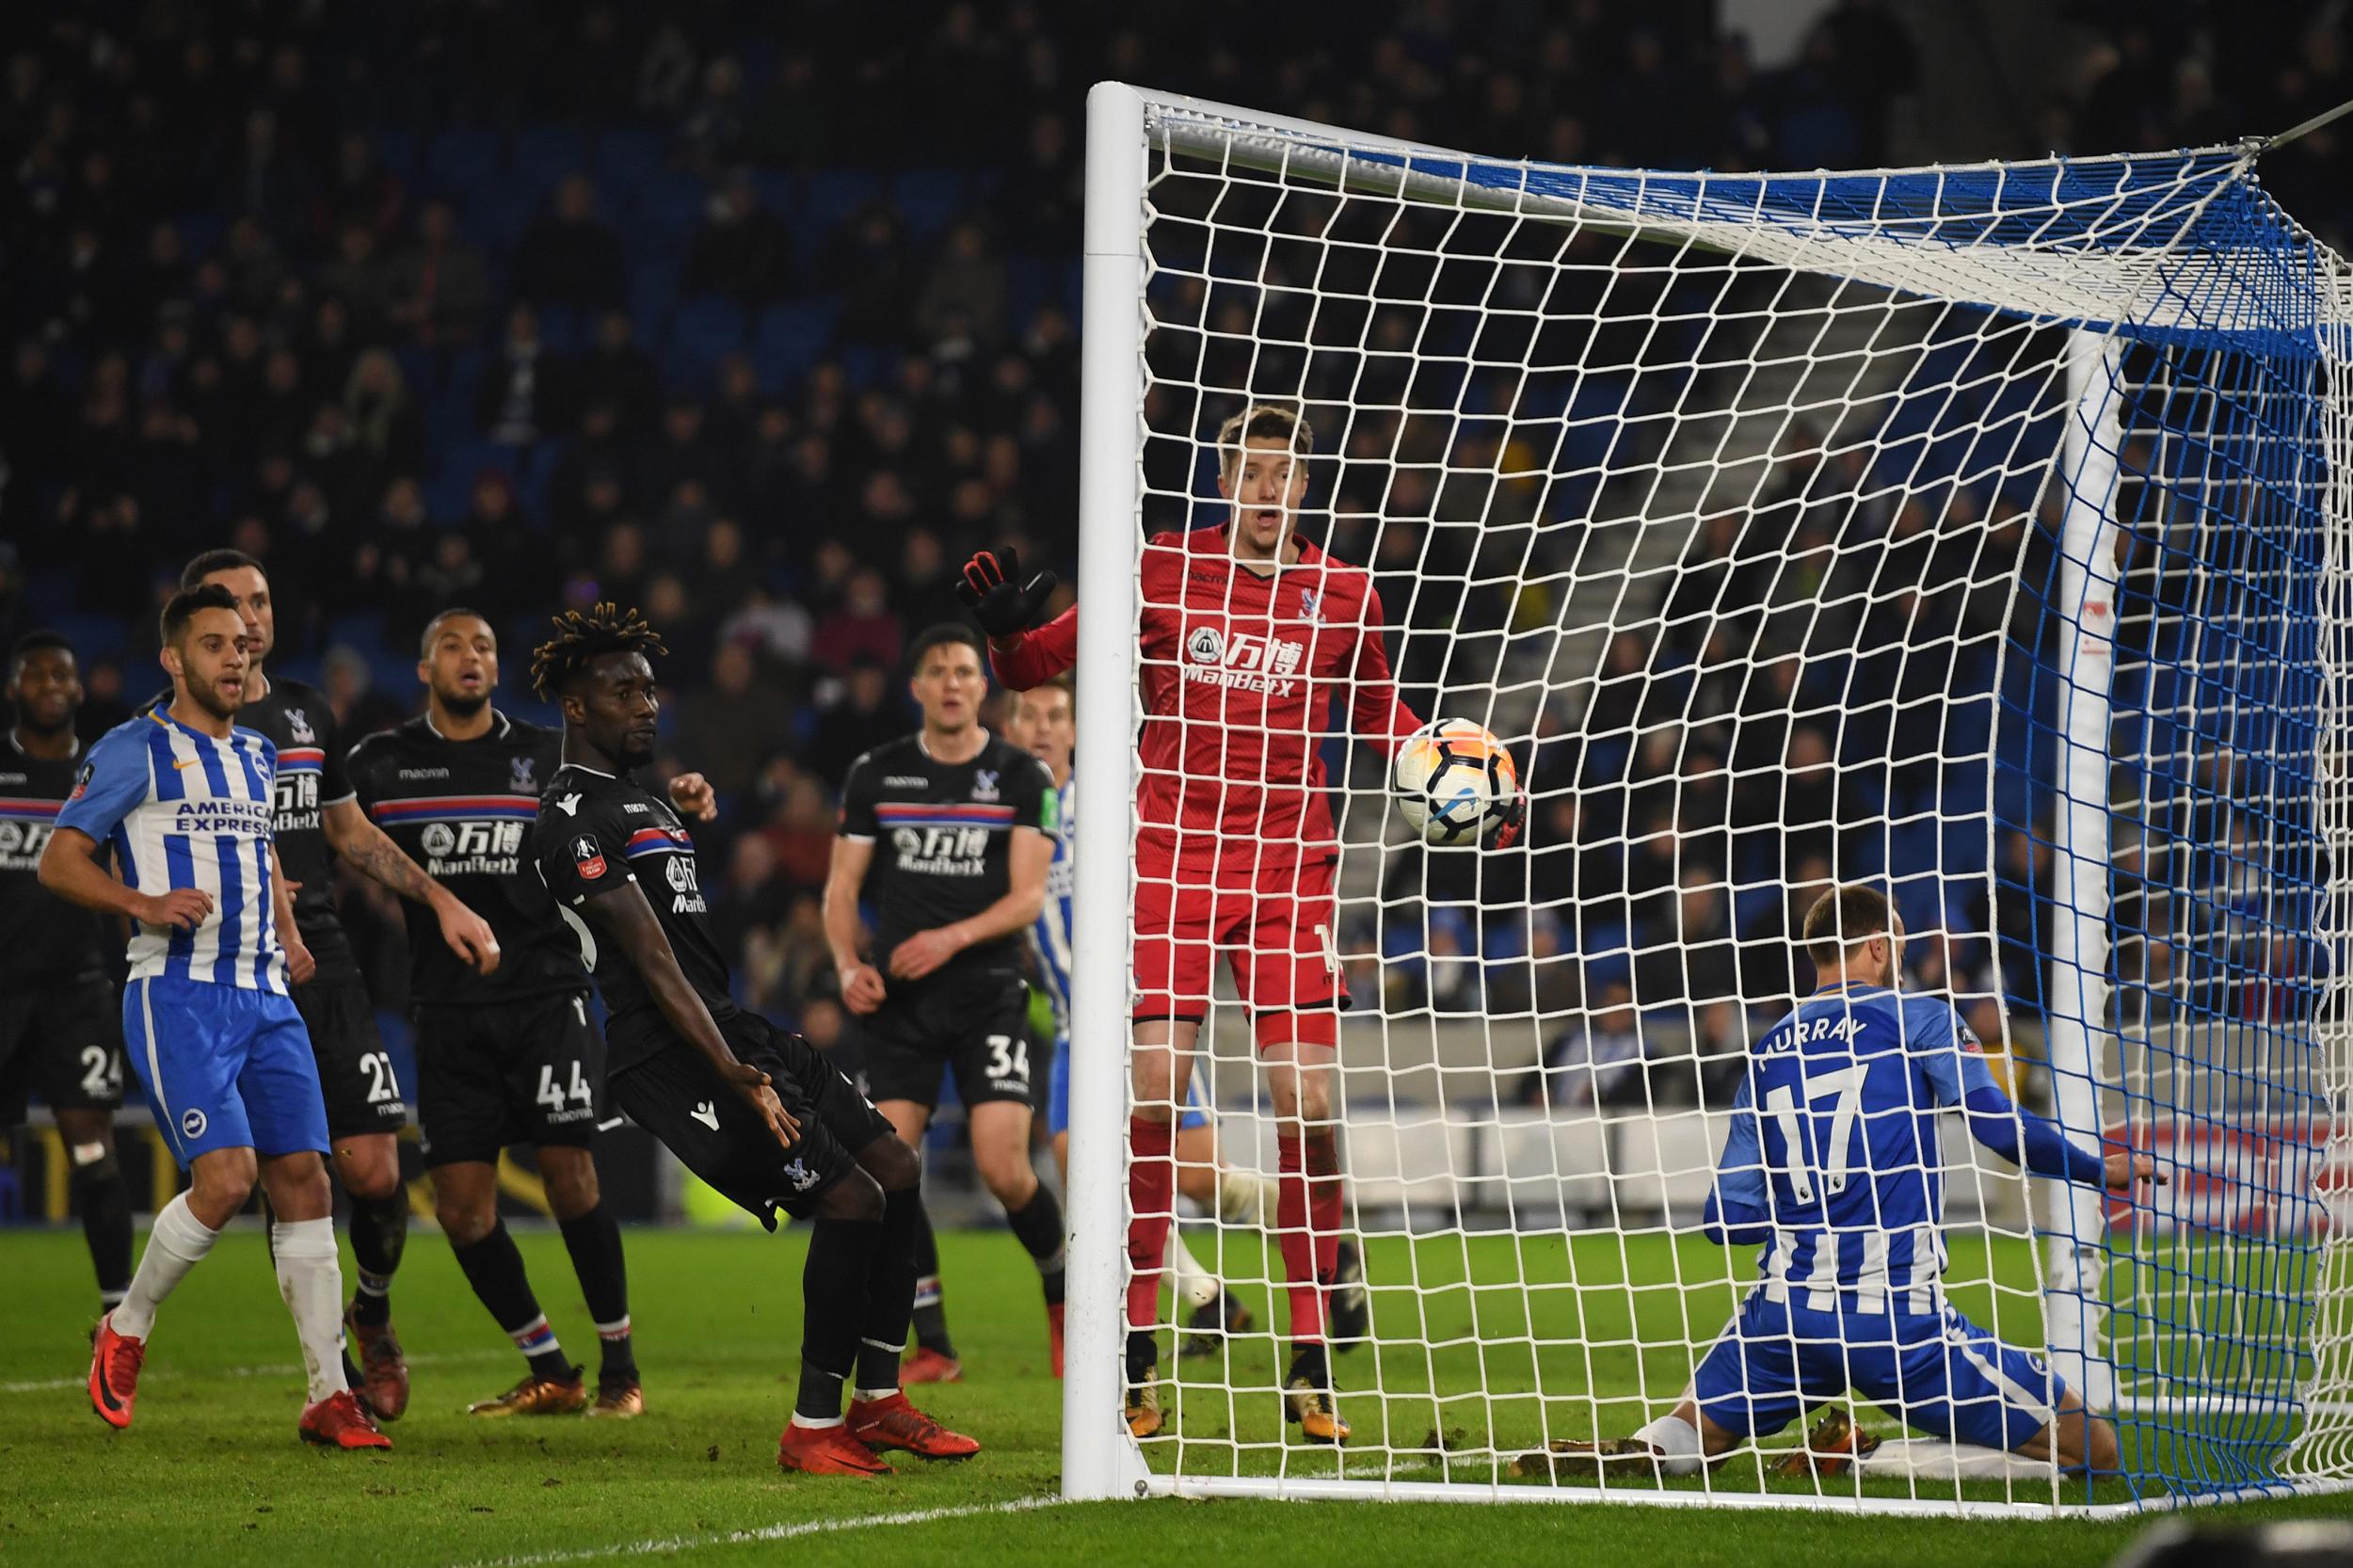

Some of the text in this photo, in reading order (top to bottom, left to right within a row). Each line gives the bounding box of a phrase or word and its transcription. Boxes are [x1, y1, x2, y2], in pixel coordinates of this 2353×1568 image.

[1225, 632, 1304, 676] 万博
[1185, 663, 1294, 697] ManBetX
[399, 767, 450, 779] macron
[176, 818, 273, 835] EXPRESS
[177, 802, 274, 821] AMERICA
[456, 821, 524, 855] 万博
[427, 855, 520, 875] ManBetX
[672, 894, 708, 914] ManB
[984, 1034, 1031, 1084] 34
[1759, 1017, 1867, 1072] MURRAY
[360, 1051, 401, 1103] 27
[536, 1060, 592, 1112] 44
[1766, 1064, 1870, 1206] 17
